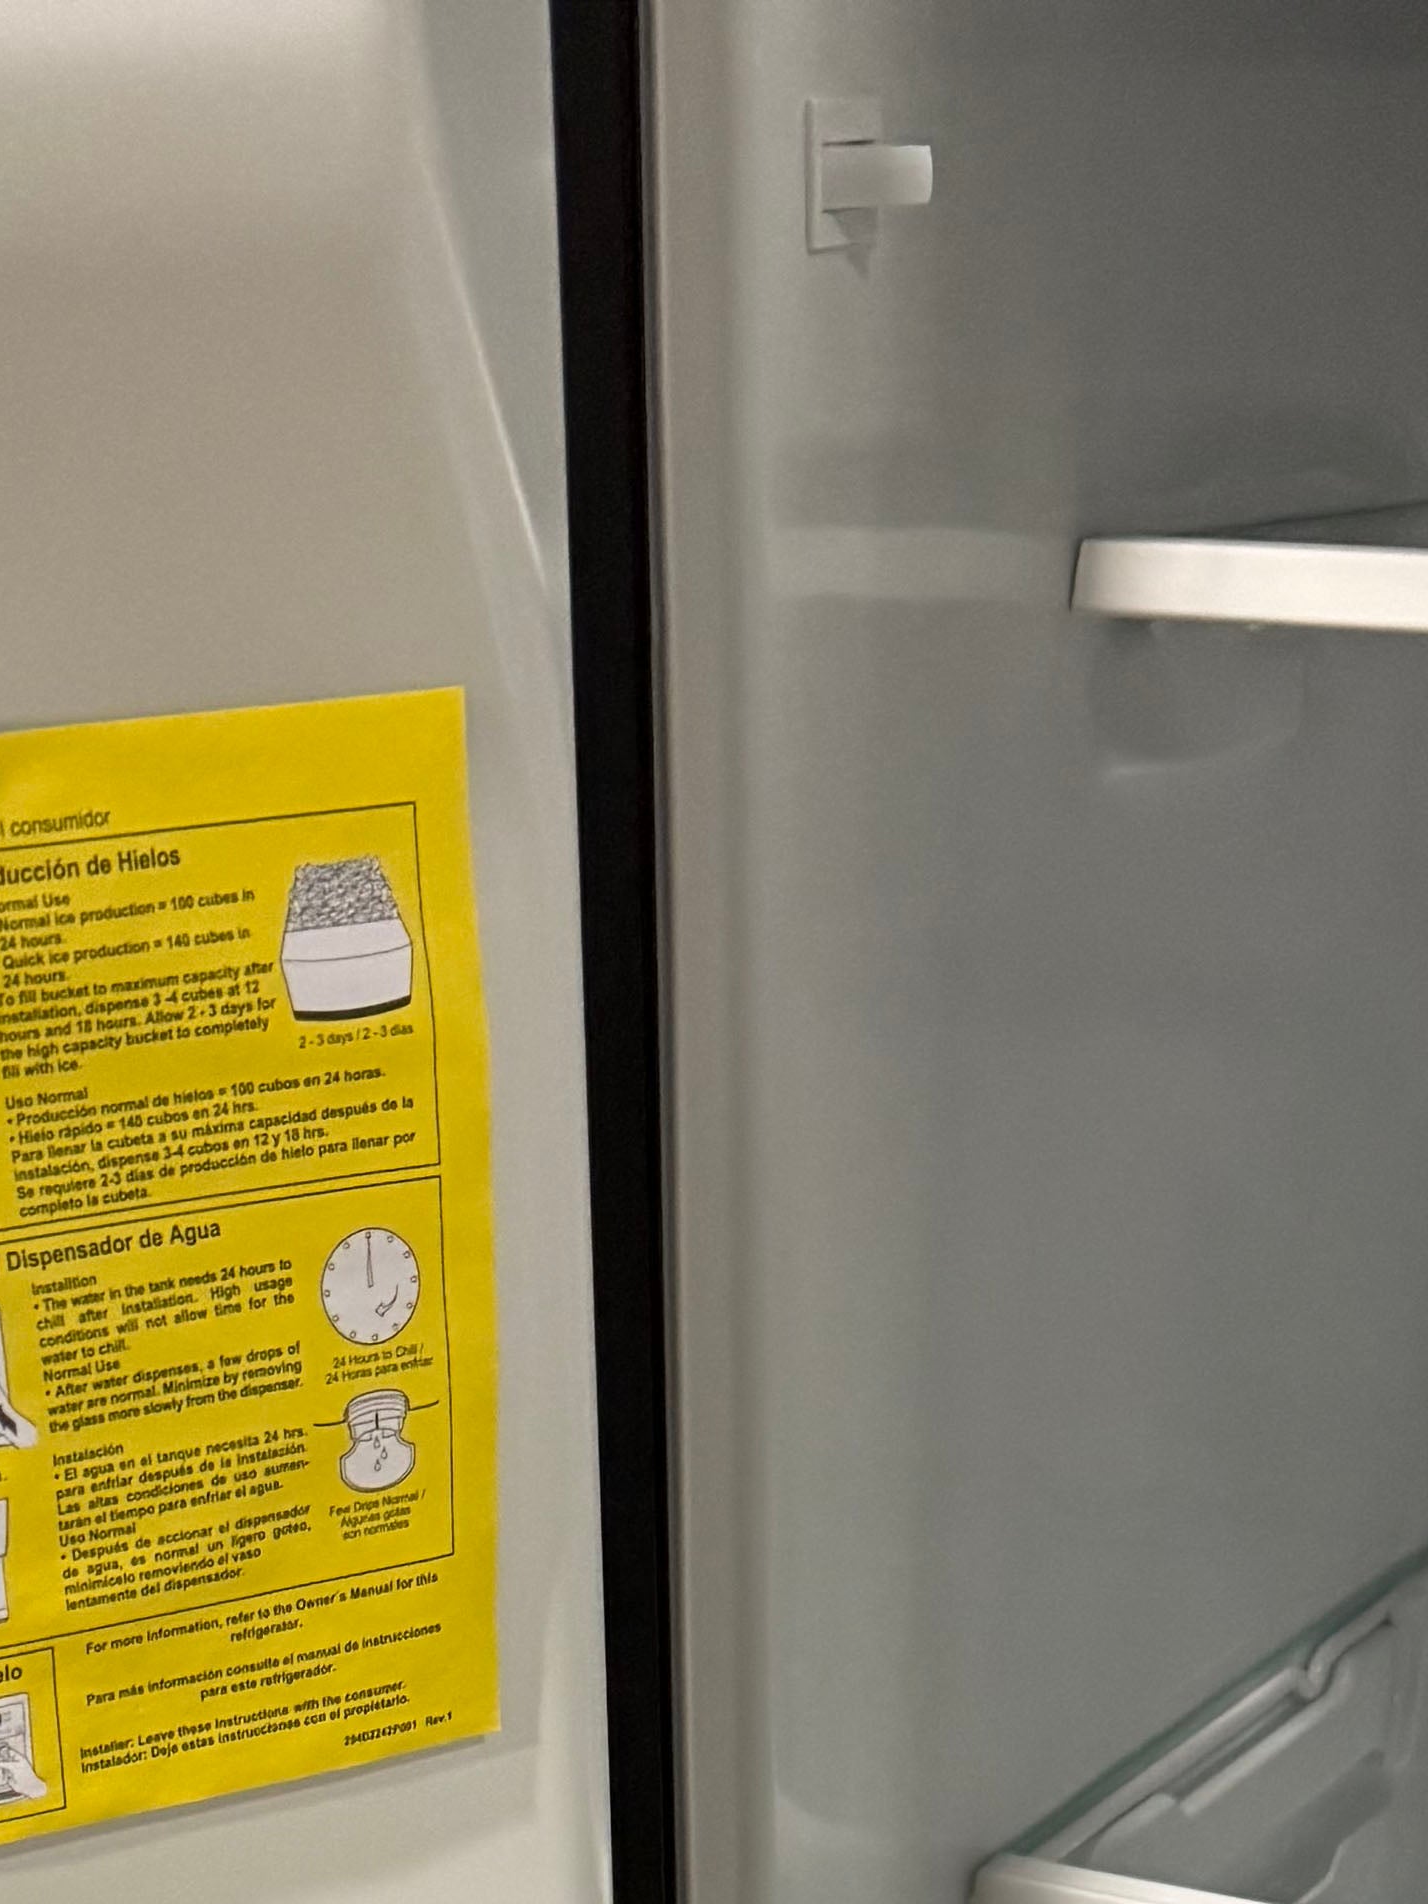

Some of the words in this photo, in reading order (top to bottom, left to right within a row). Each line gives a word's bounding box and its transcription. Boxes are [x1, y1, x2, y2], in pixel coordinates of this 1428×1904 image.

[8, 808, 111, 837] consumidor
[85, 853, 112, 877] de
[116, 846, 181, 873] Hielos
[5, 1234, 133, 1272] Dispensador
[138, 1227, 163, 1249] de
[168, 1221, 221, 1246] Agua
